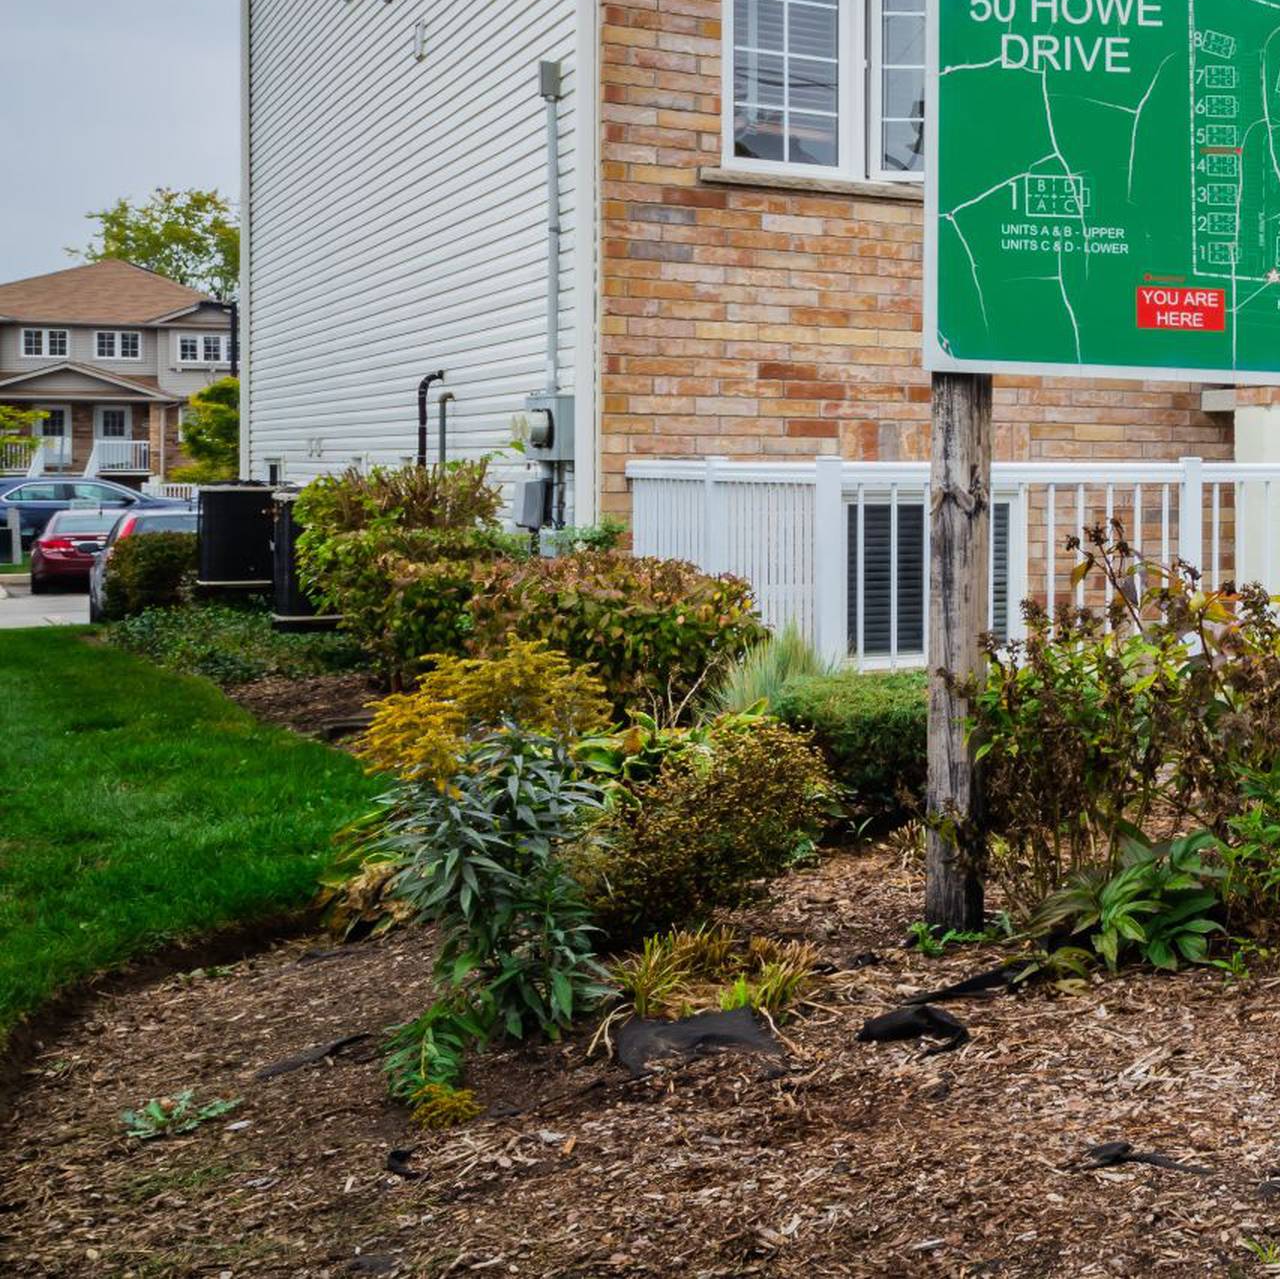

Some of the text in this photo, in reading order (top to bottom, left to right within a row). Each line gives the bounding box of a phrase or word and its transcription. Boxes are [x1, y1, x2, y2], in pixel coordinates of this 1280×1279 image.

[1194, 31, 1203, 47] 8
[1001, 33, 1131, 73] DRIVE
[1196, 69, 1204, 85] 7
[1195, 99, 1206, 114] 6
[1195, 128, 1206, 144] 5
[1196, 158, 1206, 173] 4
[1037, 179, 1046, 192] B
[1008, 181, 1017, 210] 1
[1197, 186, 1207, 202] 3
[1036, 199, 1075, 213] A C
[1001, 223, 1038, 236] UNITS
[1040, 226, 1050, 237] A
[1052, 226, 1061, 237] &
[1063, 226, 1072, 238] B
[1083, 226, 1125, 239] UPPER
[1197, 216, 1207, 232] 2
[1001, 239, 1038, 251] UNITS
[1040, 241, 1050, 251] C
[1052, 241, 1062, 252] &
[1064, 242, 1074, 253] D
[1083, 241, 1129, 255] LOWER
[1199, 244, 1206, 260] 1
[1142, 290, 1219, 308] YOU ARE
[1156, 311, 1204, 328] HERE
